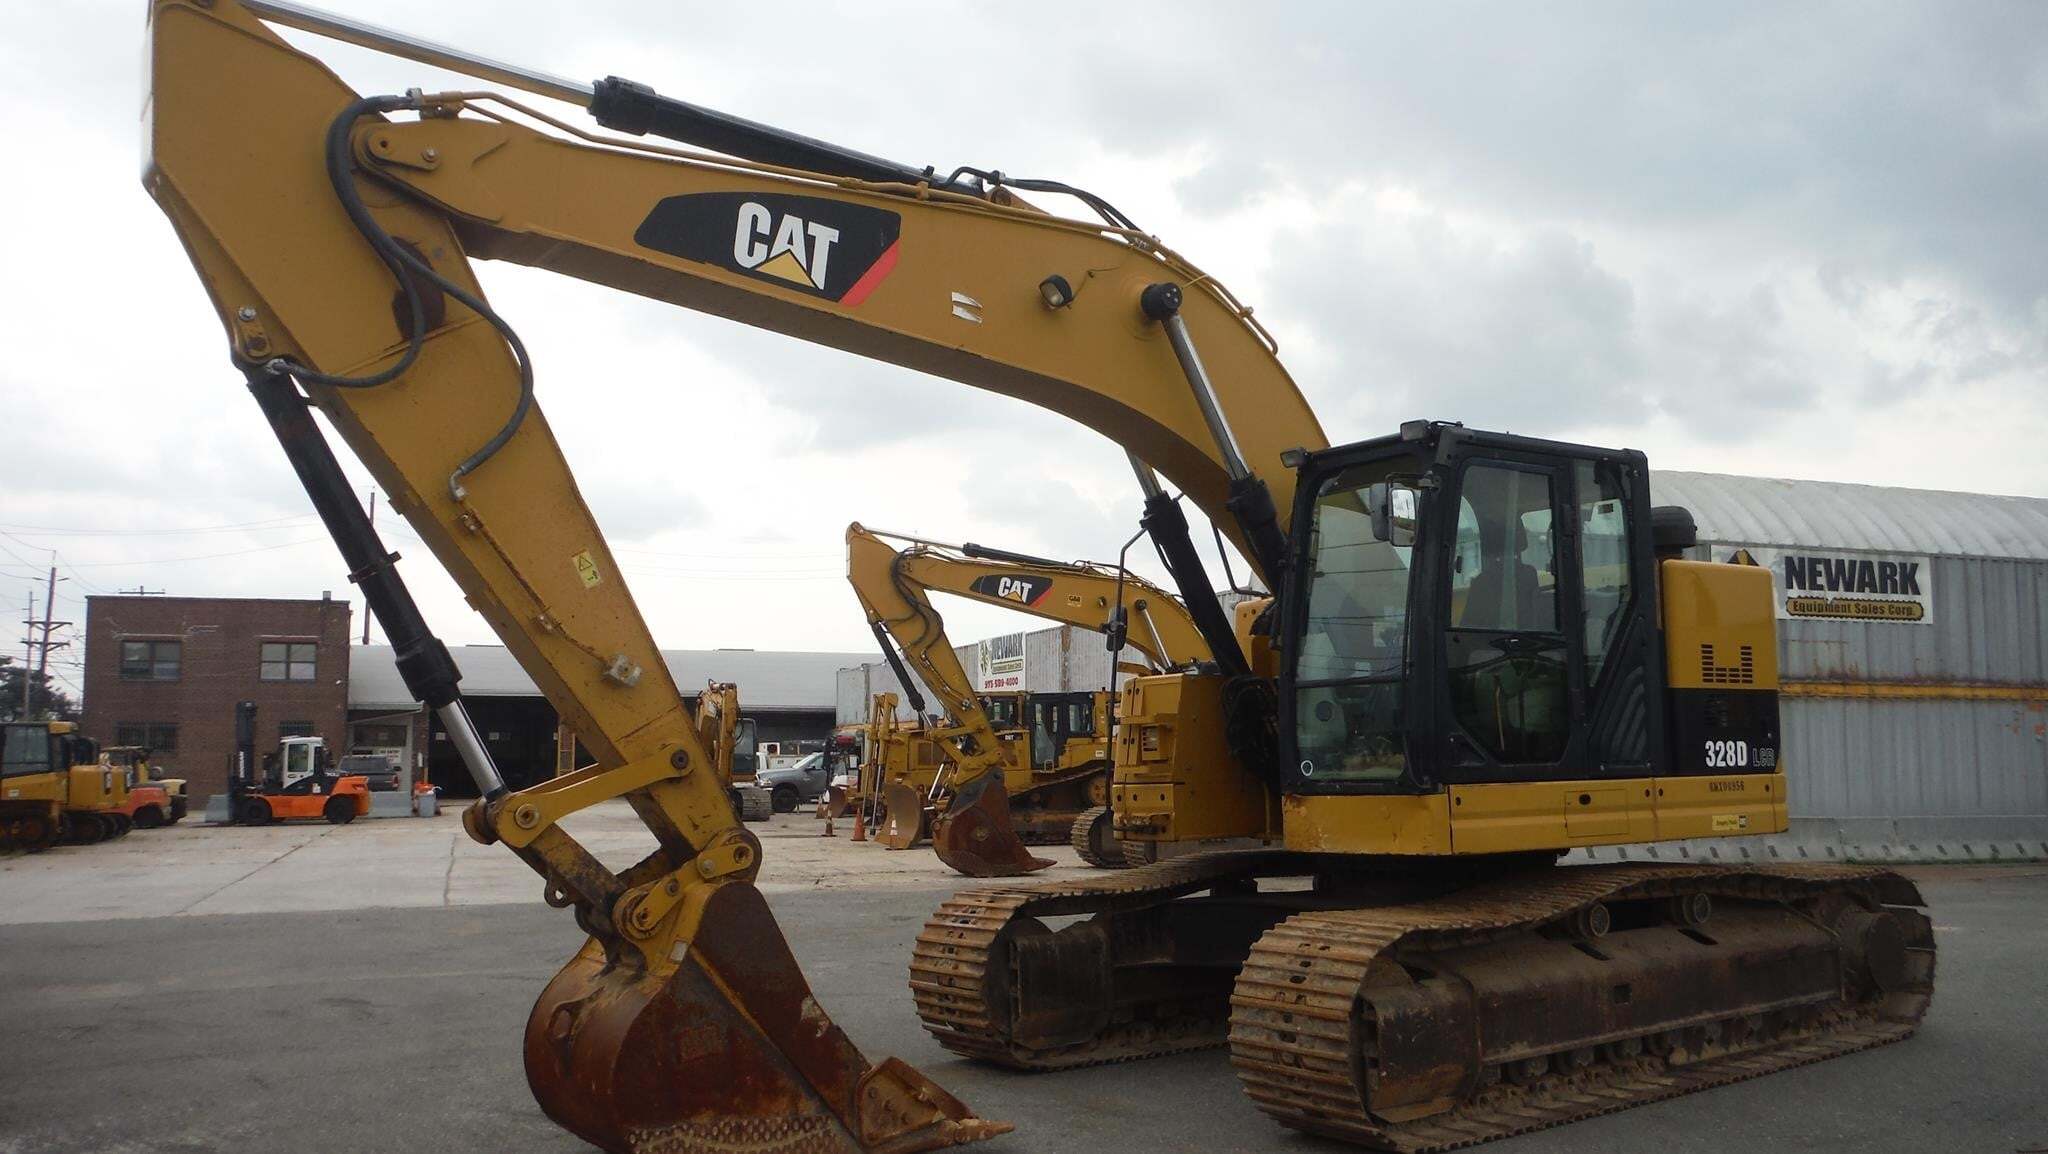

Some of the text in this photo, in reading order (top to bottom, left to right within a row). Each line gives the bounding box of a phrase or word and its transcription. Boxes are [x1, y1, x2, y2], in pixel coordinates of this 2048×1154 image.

[733, 201, 840, 291] CAT
[997, 576, 1033, 603] CAT
[1784, 555, 1921, 596] NEWARK
[1793, 600, 1916, 617] Equipment Sales Corp.
[991, 632, 1024, 660] NEWARK
[1704, 740, 1748, 768] 328D
